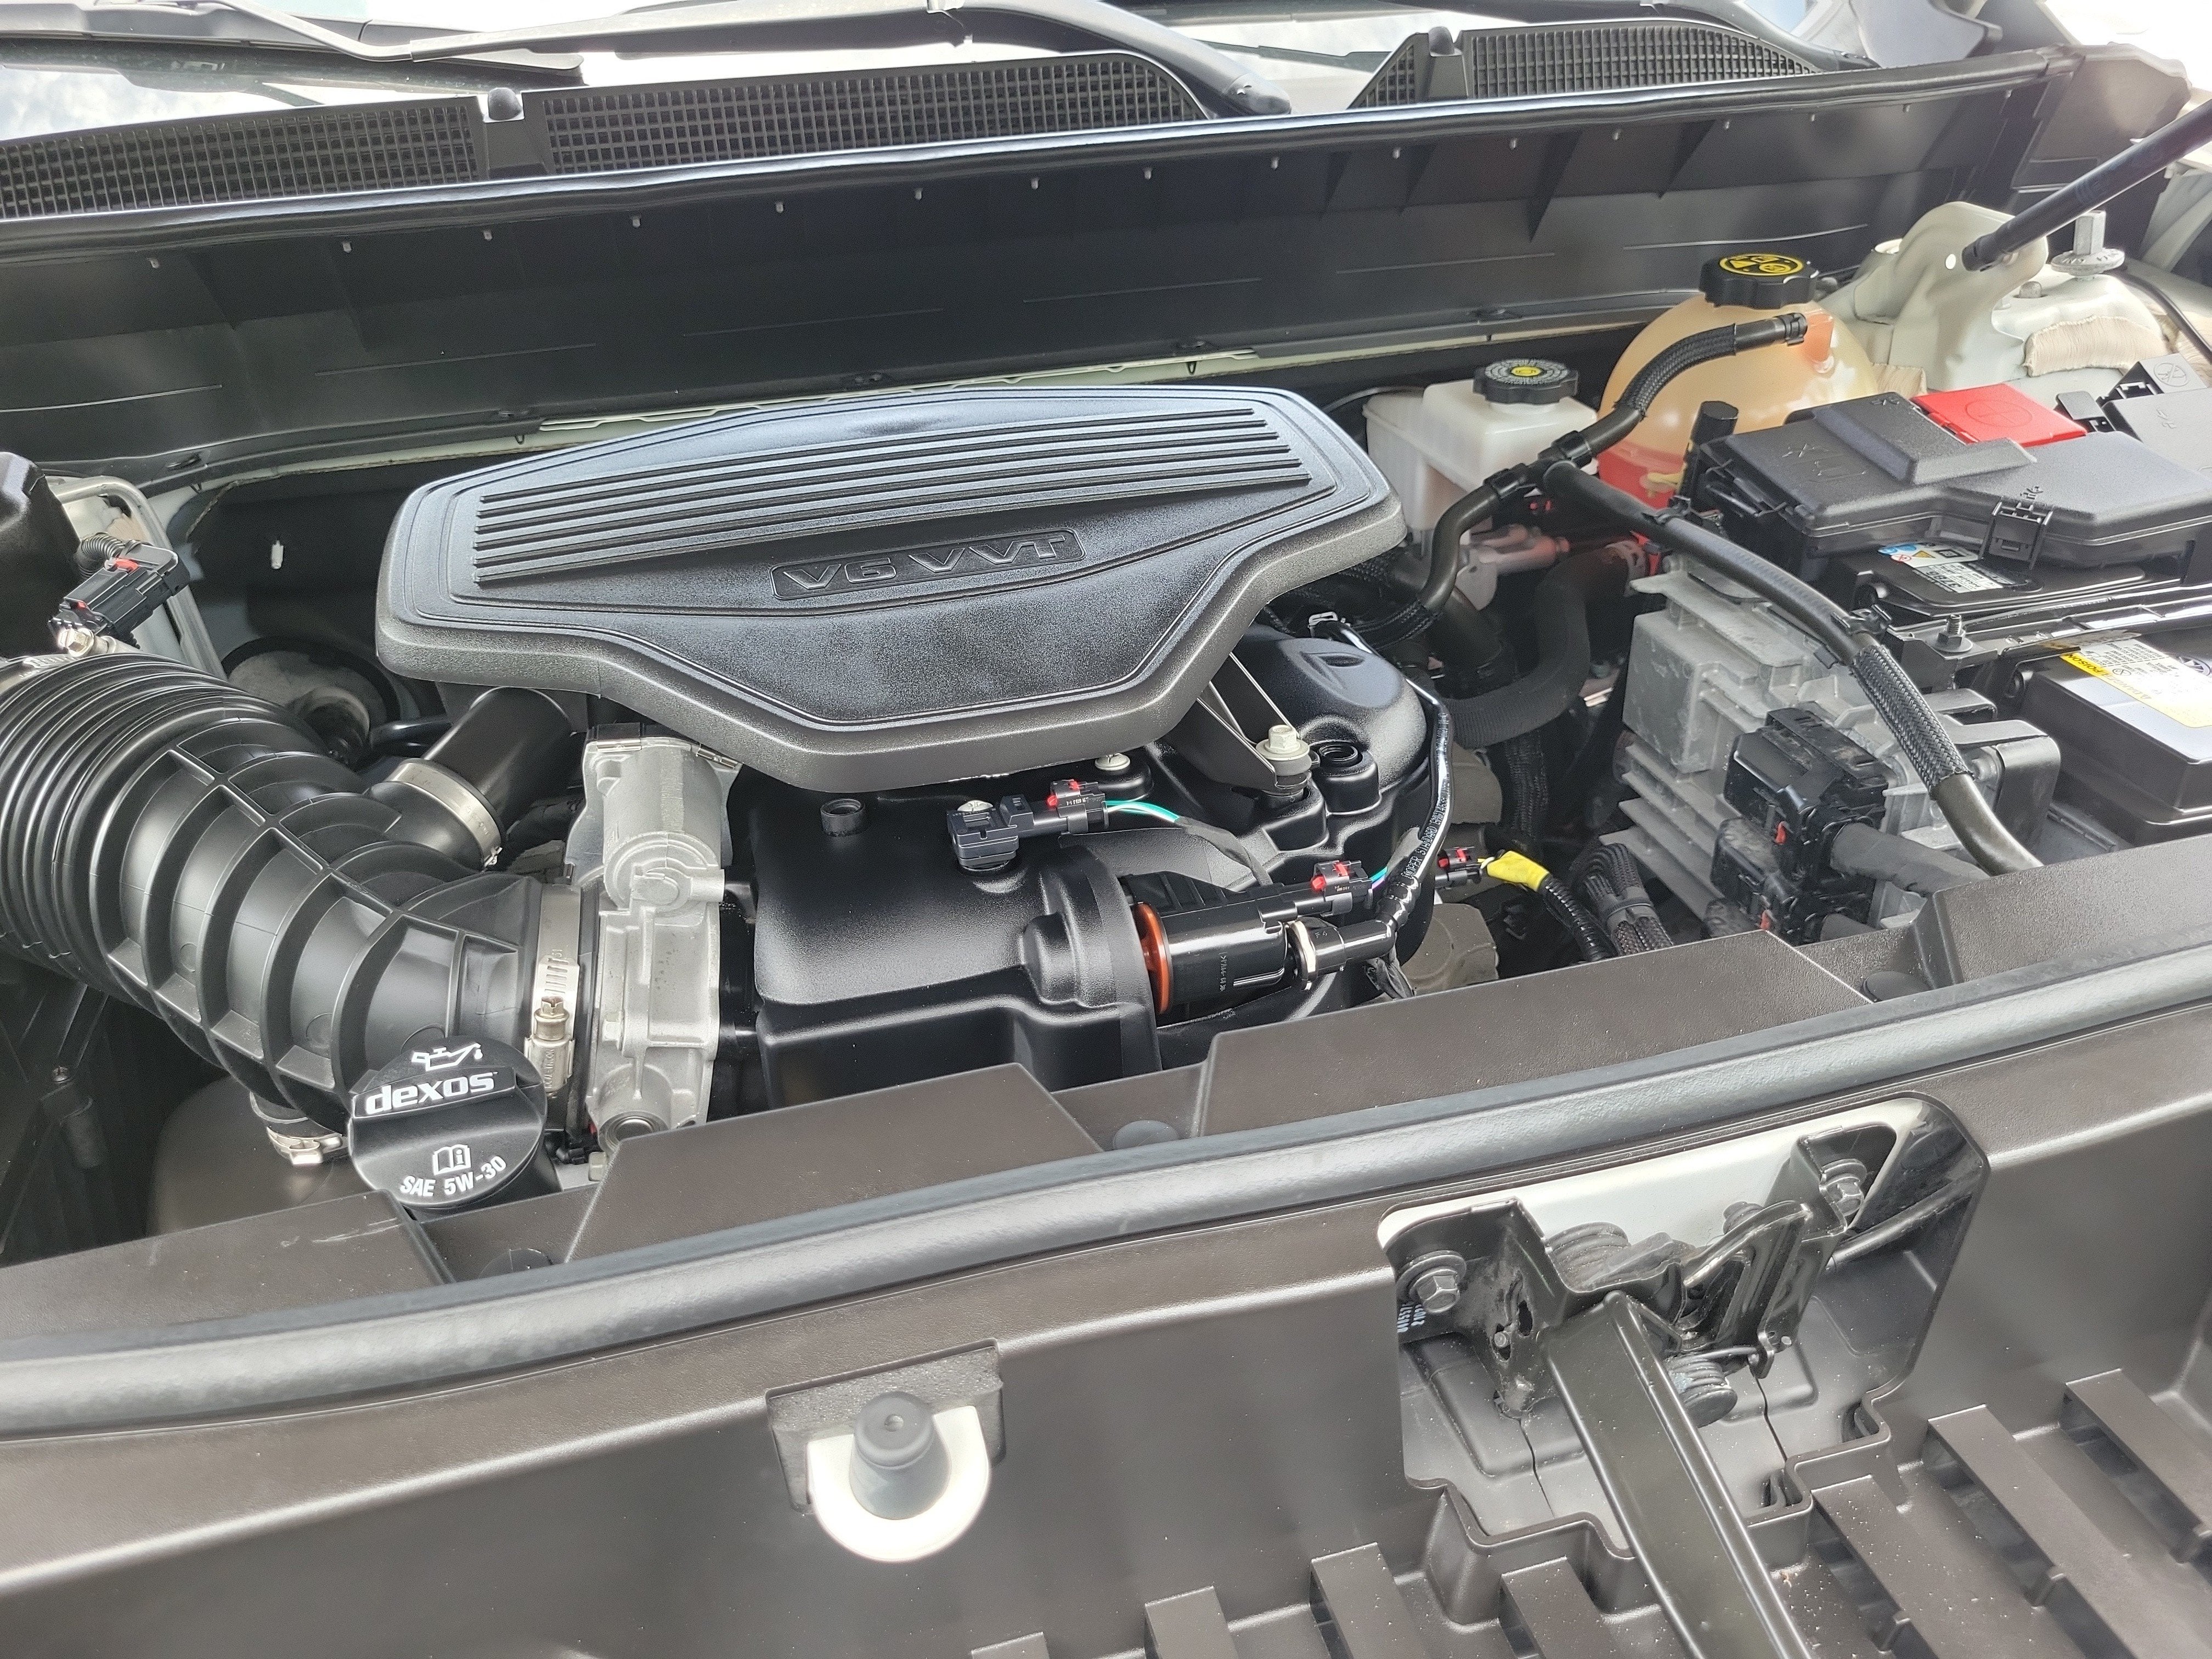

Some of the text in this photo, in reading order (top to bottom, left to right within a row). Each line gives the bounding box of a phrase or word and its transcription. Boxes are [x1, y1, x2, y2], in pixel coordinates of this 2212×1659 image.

[783, 534, 1066, 590] V6 VVT
[366, 1073, 495, 1115] dexos
[400, 1155, 507, 1197] SAE 5W-30
